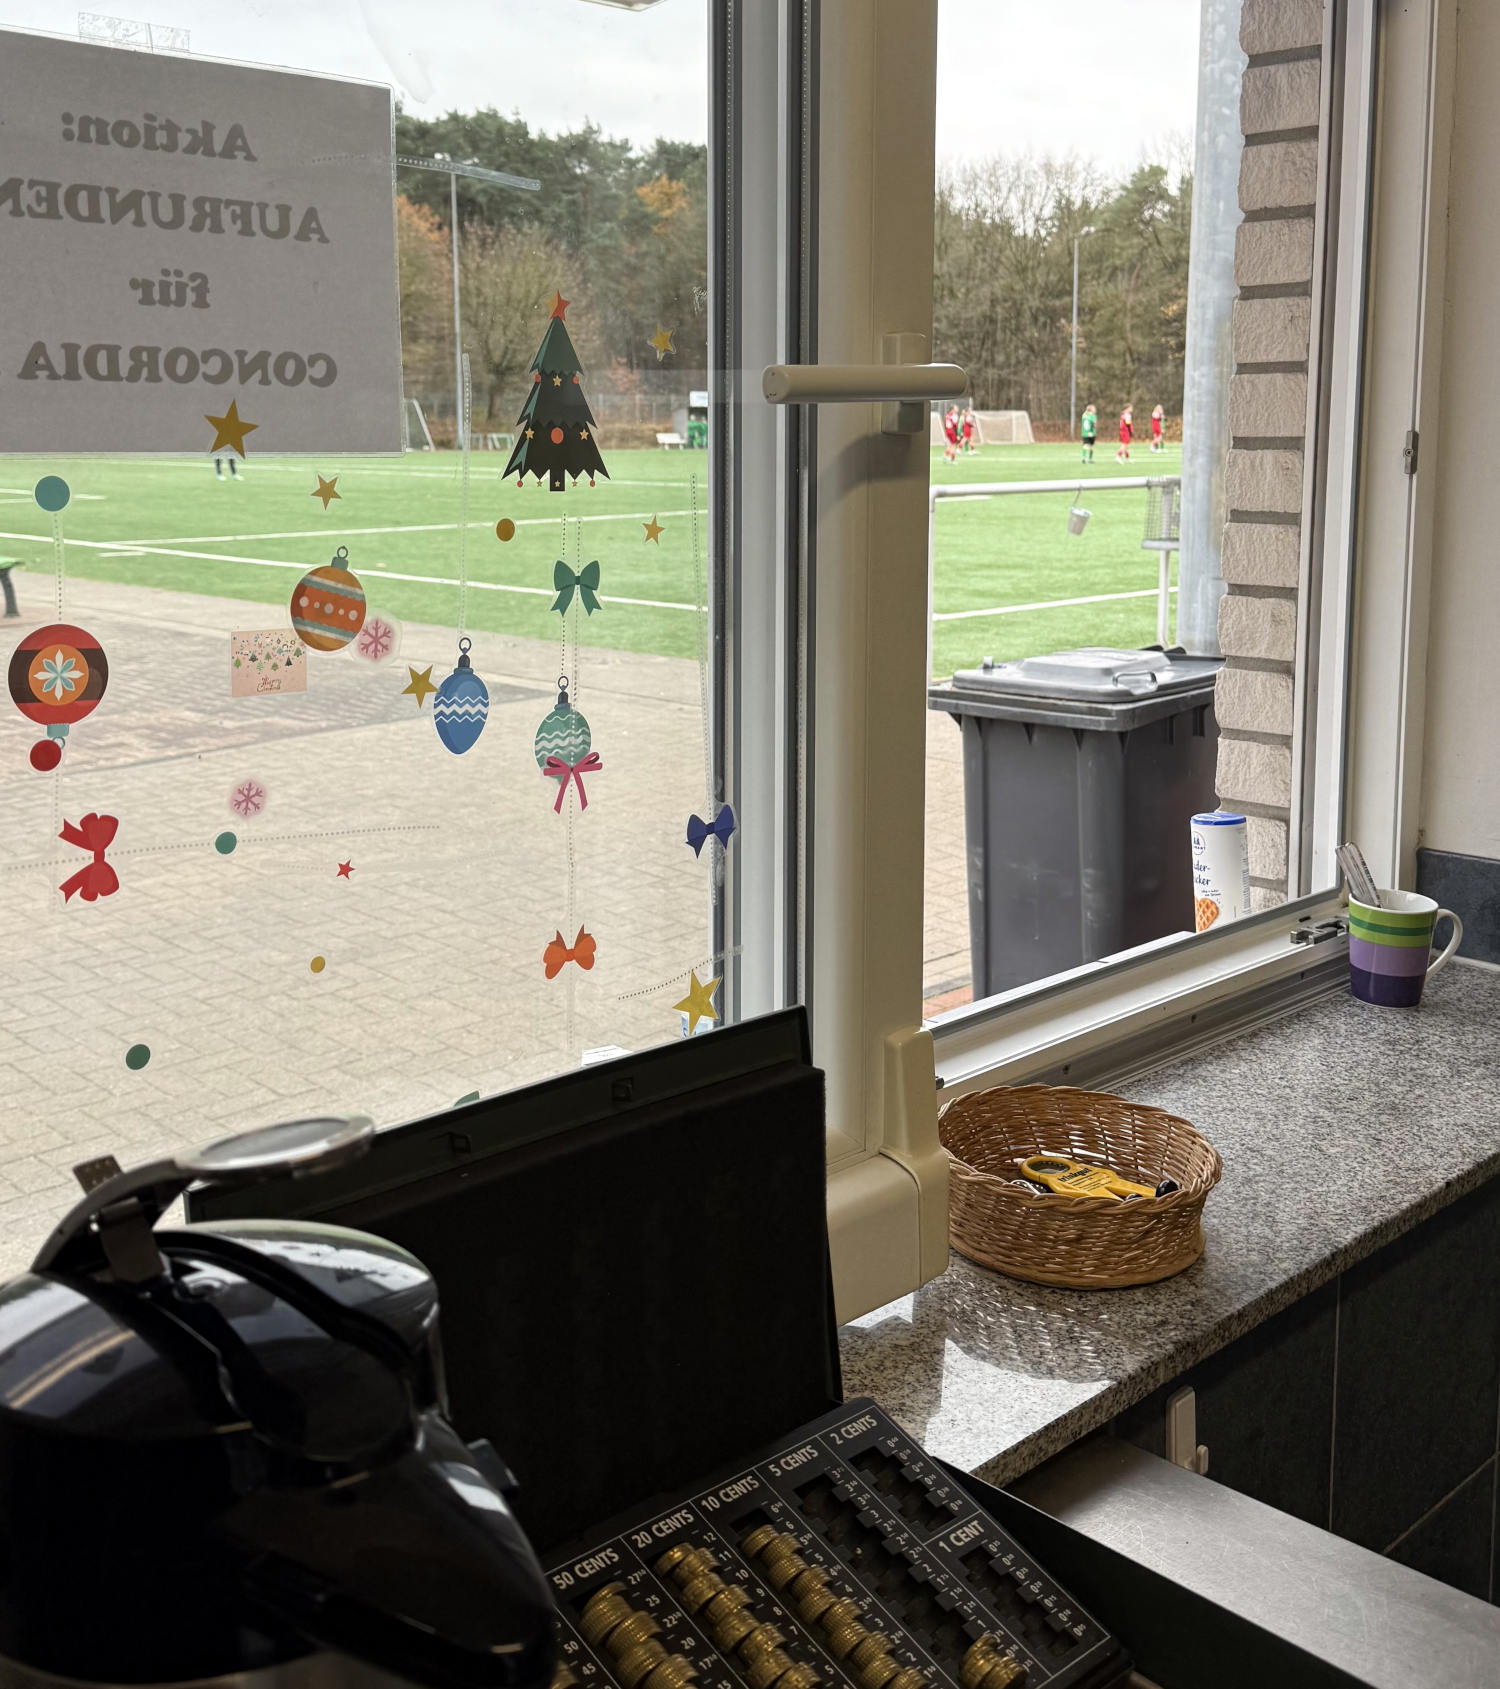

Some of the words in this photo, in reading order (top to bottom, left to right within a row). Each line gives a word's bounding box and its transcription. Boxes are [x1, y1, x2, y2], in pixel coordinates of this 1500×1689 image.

[830, 1433, 844, 1445] 2
[840, 1415, 878, 1439] CENTS
[768, 1464, 782, 1477] 5
[780, 1444, 818, 1471] CENTS
[701, 1496, 720, 1512] 10
[718, 1475, 759, 1503] CENTS
[870, 1510, 879, 1518] 3
[631, 1530, 653, 1549] 20
[651, 1508, 695, 1538] CENTS
[785, 1520, 794, 1530] 6
[703, 1532, 717, 1543] 12
[939, 1540, 952, 1553] 1
[949, 1519, 985, 1547] CENT
[718, 1550, 732, 1561] 11
[814, 1553, 824, 1562] 5
[552, 1571, 575, 1590] 50
[574, 1547, 620, 1578] CENTS
[922, 1563, 932, 1573] 2
[735, 1569, 749, 1580] 10
[756, 1588, 765, 1597] 9
[645, 1594, 661, 1608] 25
[773, 1606, 782, 1616] 8
[874, 1618, 884, 1628] 3
[789, 1625, 799, 1635] 7
[563, 1640, 579, 1654] 50
[680, 1636, 696, 1651] 20
[906, 1652, 917, 1662] 2
[582, 1662, 597, 1676] 45
[824, 1664, 835, 1675] 5
